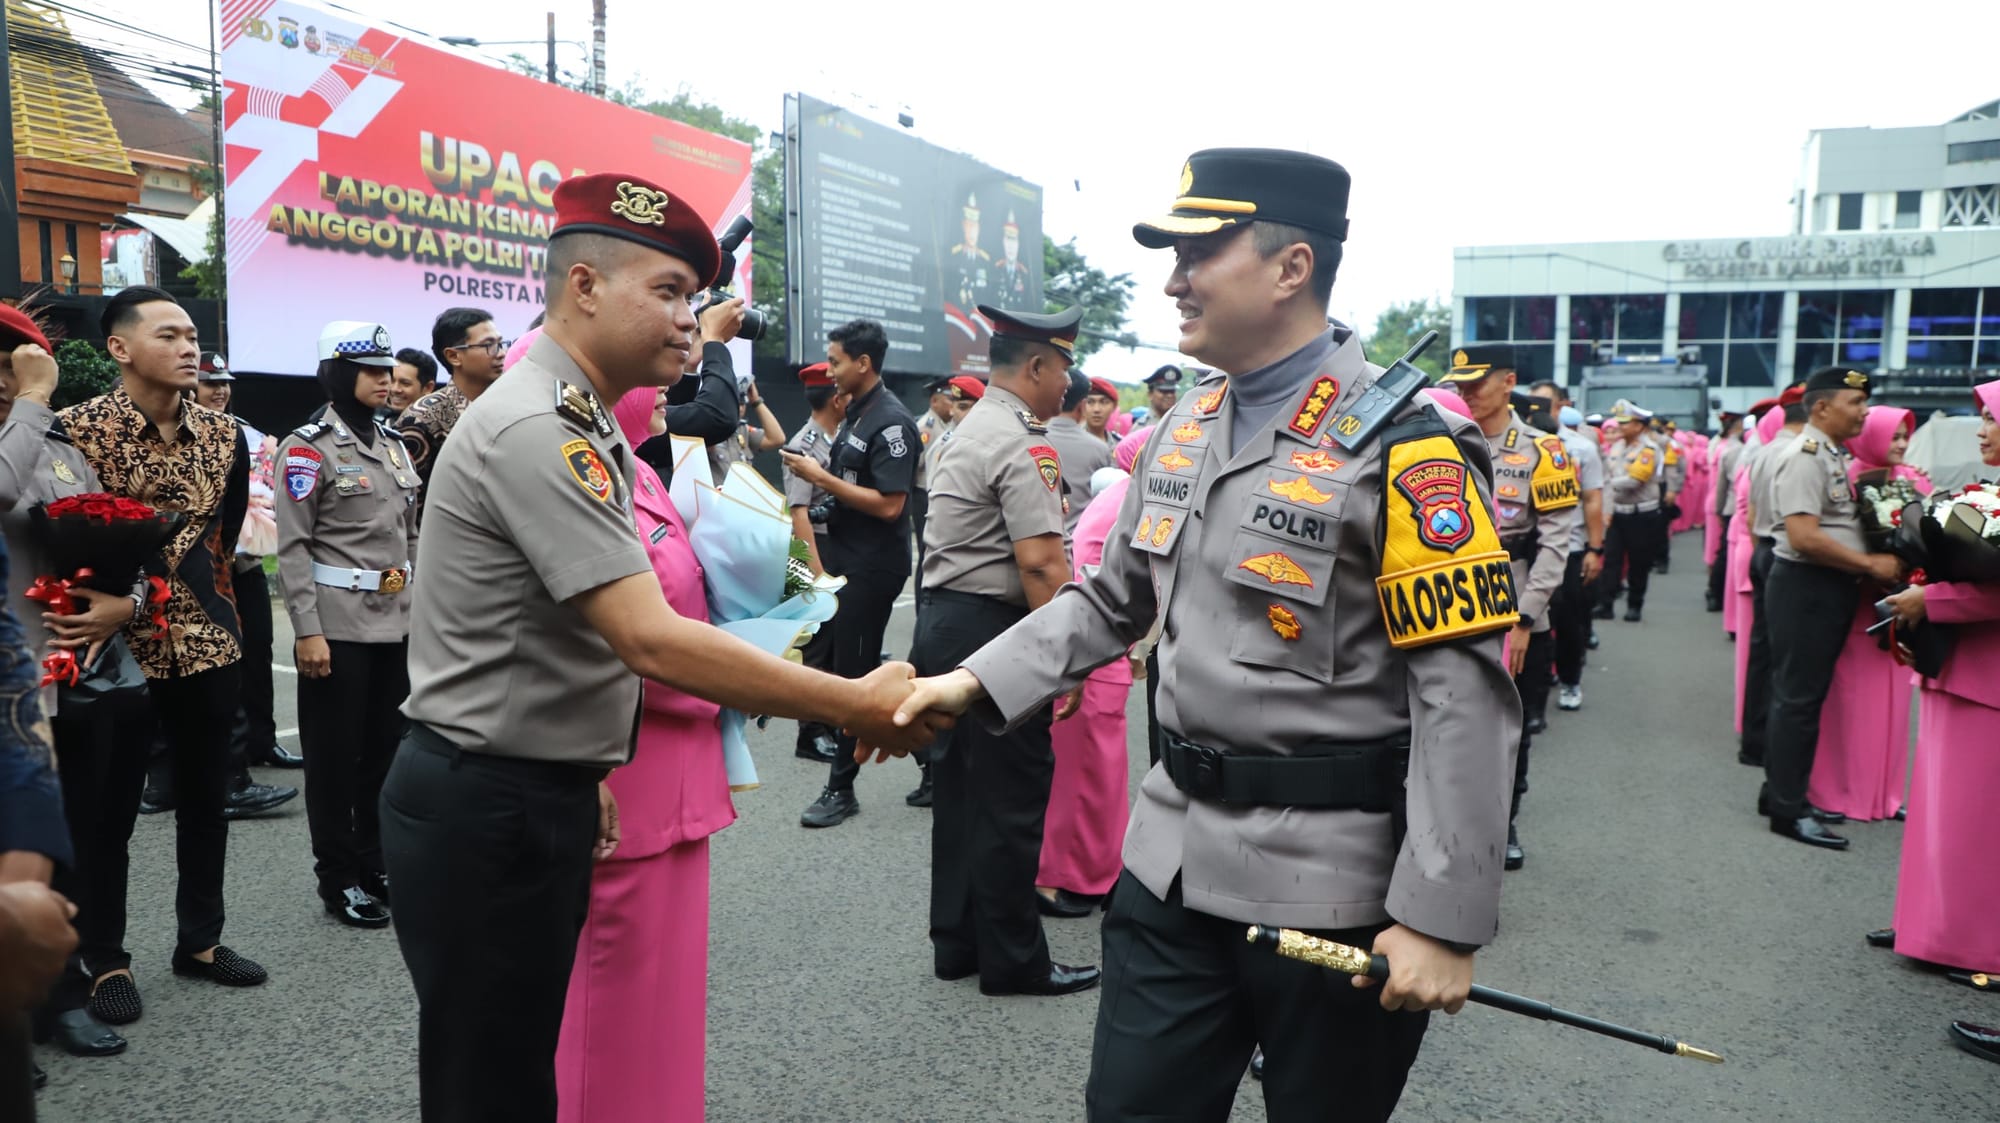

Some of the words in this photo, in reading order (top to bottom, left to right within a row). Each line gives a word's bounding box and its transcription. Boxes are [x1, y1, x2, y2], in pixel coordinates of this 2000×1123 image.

[420, 130, 586, 208] UPAC
[318, 170, 471, 226] LAPORAN
[266, 203, 439, 258] ANGGOTA
[444, 232, 523, 270] POLRI
[1777, 259, 1850, 277] MALANG
[1858, 258, 1905, 275] KOTA
[424, 271, 531, 304] POLRESTA
[1149, 476, 1189, 502] NANANG
[1495, 468, 1530, 480] POLRI
[1251, 503, 1327, 543] POLRI
